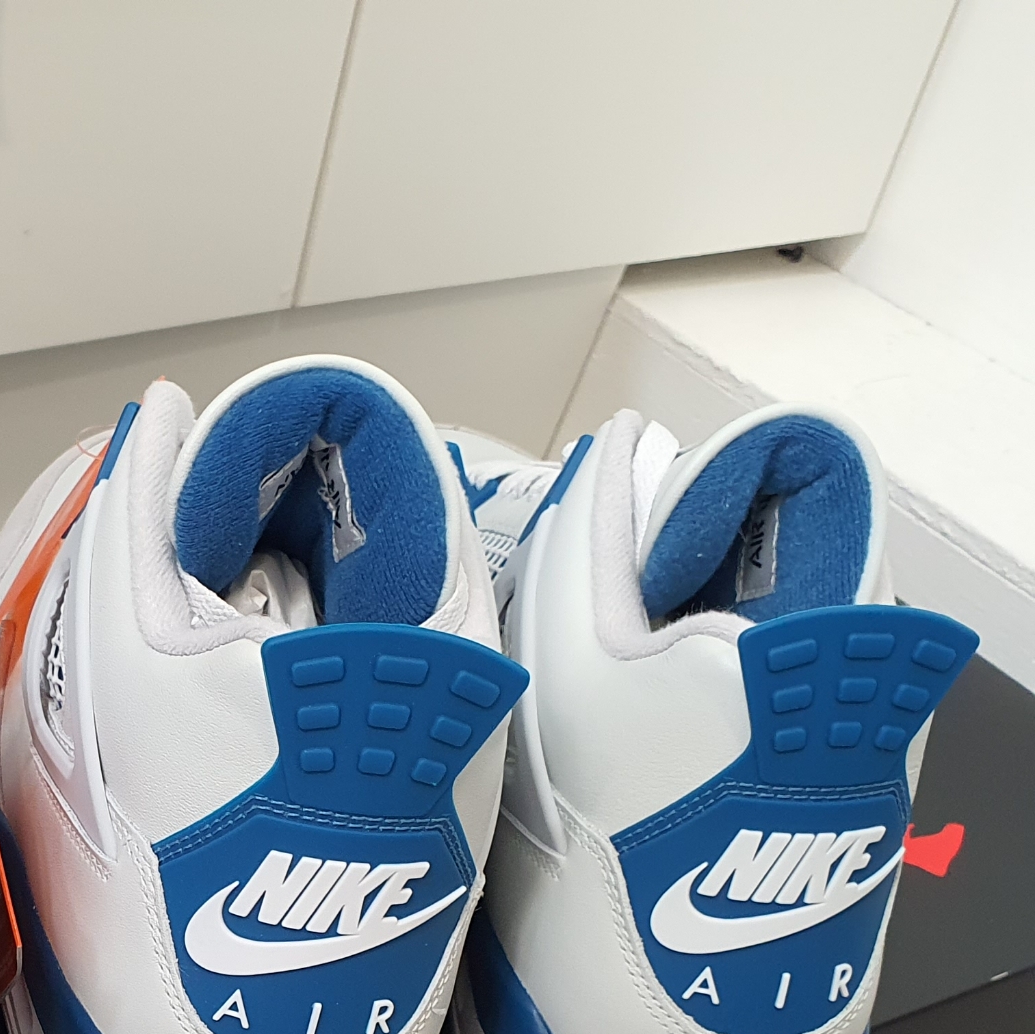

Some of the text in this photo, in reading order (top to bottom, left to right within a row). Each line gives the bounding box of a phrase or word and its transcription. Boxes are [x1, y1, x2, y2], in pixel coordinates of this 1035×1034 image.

[749, 520, 765, 568] AIR
[228, 849, 430, 935] NIKE
[697, 825, 886, 905] NIKE
[681, 962, 853, 1010] AIR
